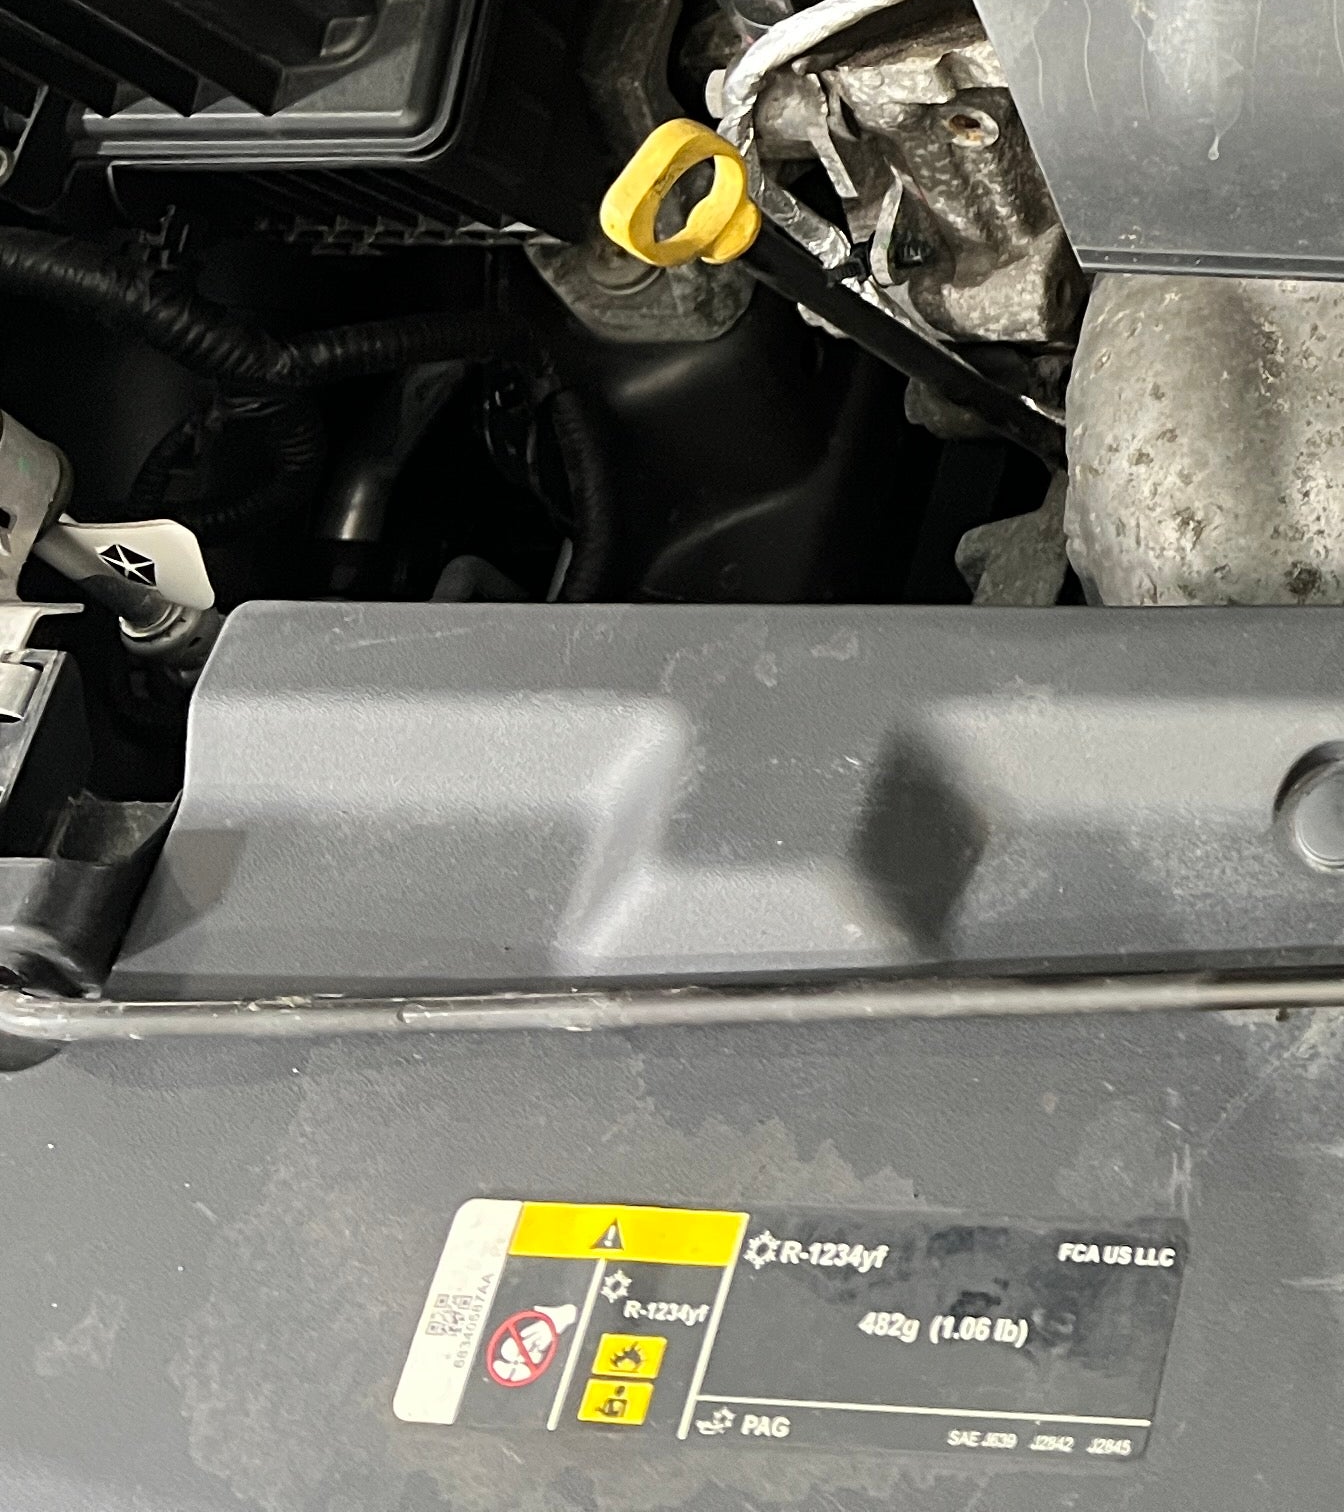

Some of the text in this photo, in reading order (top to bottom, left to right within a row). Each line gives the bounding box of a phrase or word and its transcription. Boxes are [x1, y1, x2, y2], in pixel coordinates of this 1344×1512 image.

[780, 1241, 1176, 1273] R-1234yf FCA US LLC
[624, 1300, 709, 1326] R-1234yf
[858, 1312, 1028, 1348] 482g (1.06 lb)
[741, 1415, 791, 1438] PAG
[947, 1430, 981, 1448] SAE
